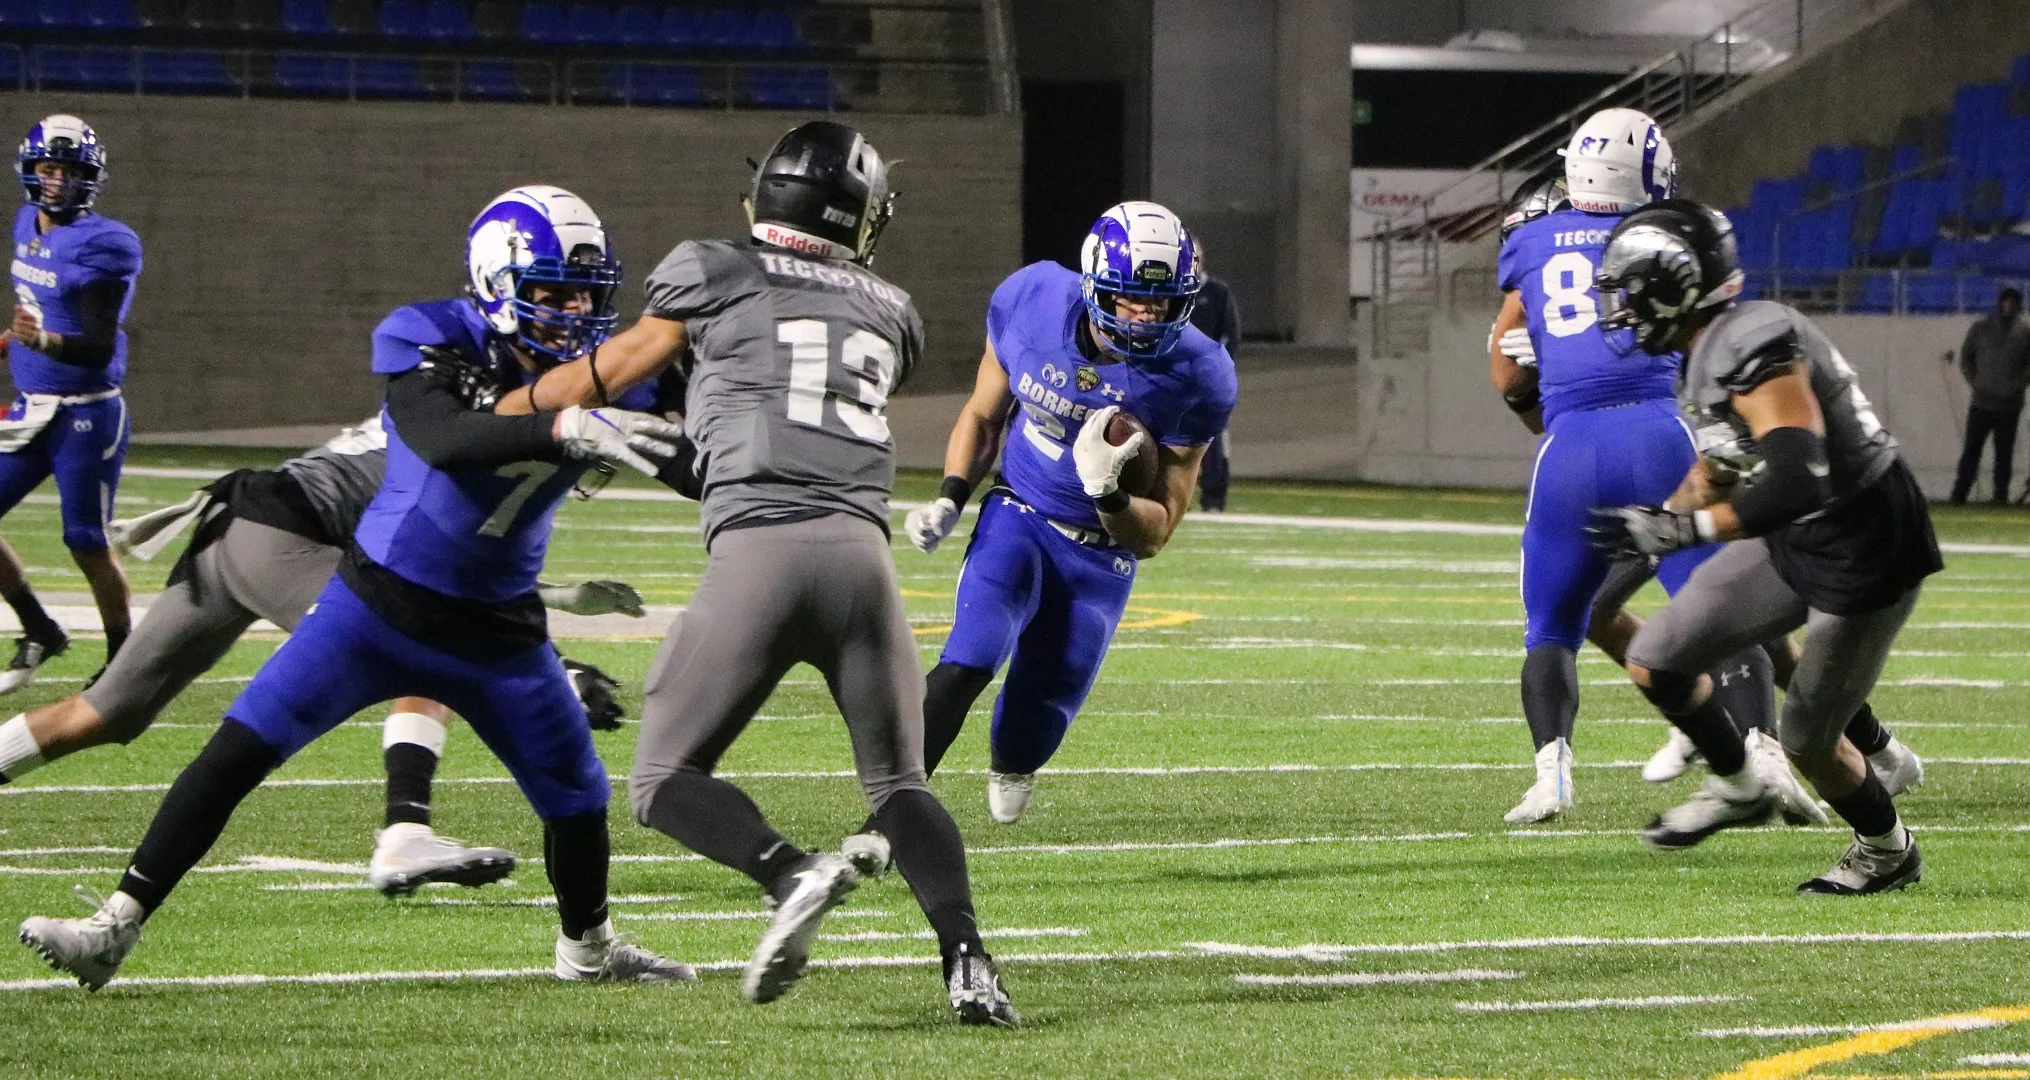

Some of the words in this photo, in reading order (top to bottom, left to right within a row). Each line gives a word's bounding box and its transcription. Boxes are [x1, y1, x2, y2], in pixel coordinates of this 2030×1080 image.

[1578, 136, 1609, 156] 87
[1573, 200, 1620, 213] Riddell
[767, 228, 833, 255] Riddell
[1554, 231, 1585, 247] TEC
[758, 252, 813, 278] TEC
[777, 318, 896, 443] 13
[1023, 401, 1066, 462] 2
[477, 460, 560, 537] 7
